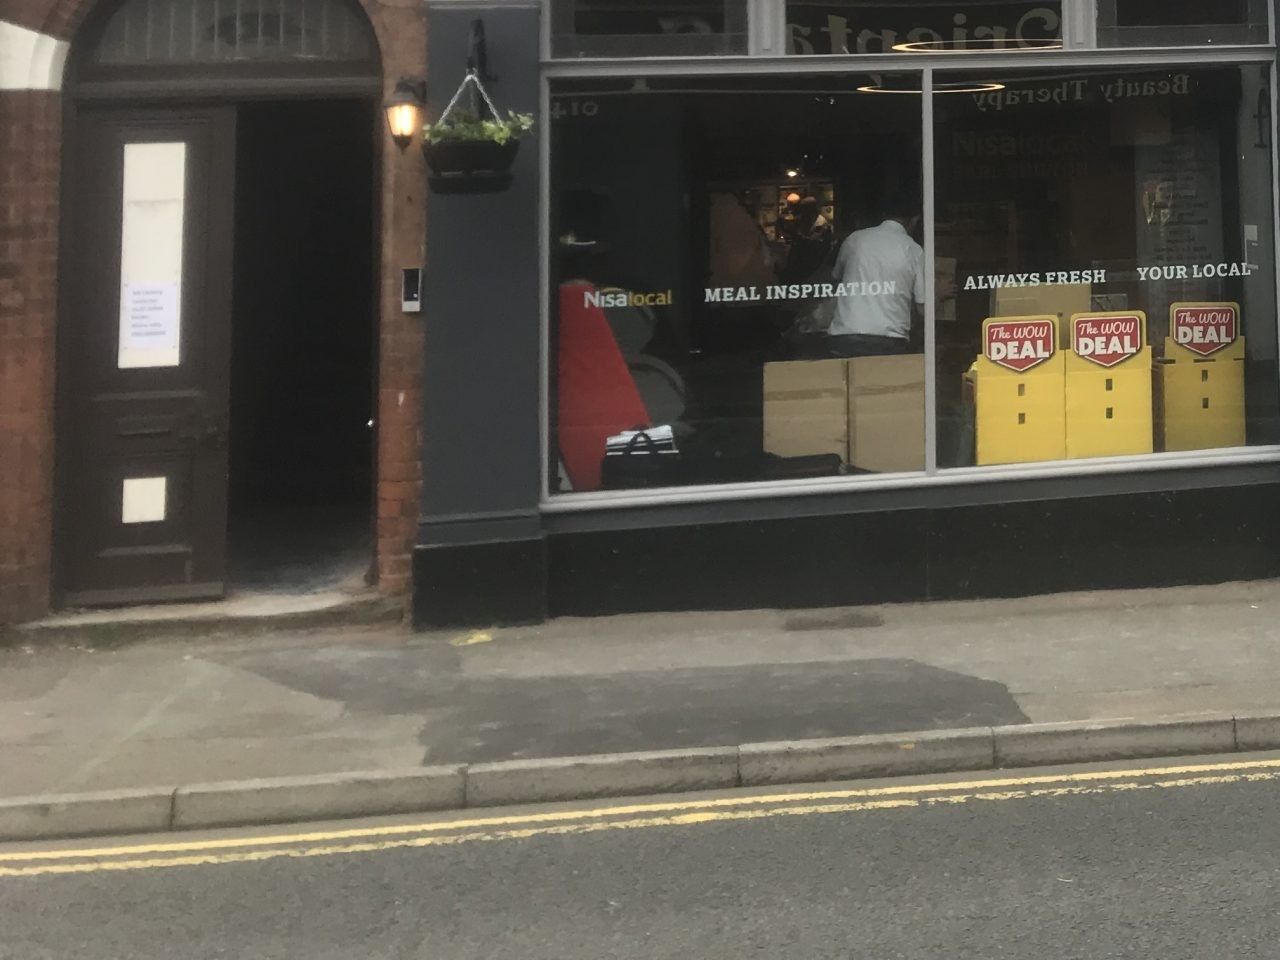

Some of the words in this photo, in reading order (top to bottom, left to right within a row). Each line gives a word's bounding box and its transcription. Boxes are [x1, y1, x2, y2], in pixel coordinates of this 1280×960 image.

[964, 273, 1041, 290] ALWAYS
[1046, 269, 1106, 286] FRESH
[1137, 265, 1188, 281] YOUR
[1192, 262, 1252, 279] LOCAL
[584, 289, 672, 308] Nisalocal
[704, 285, 761, 303] MEAL
[766, 281, 897, 300] INSPIRATION
[1178, 313, 1197, 325] The
[1198, 310, 1230, 324] WOW
[990, 327, 1011, 341] The
[1012, 325, 1047, 339] WOW
[1078, 323, 1099, 336] The
[1100, 321, 1134, 335] WOW
[1178, 326, 1231, 344] DEAL
[990, 342, 1050, 361] DEAL
[1078, 337, 1137, 356] DEAL
